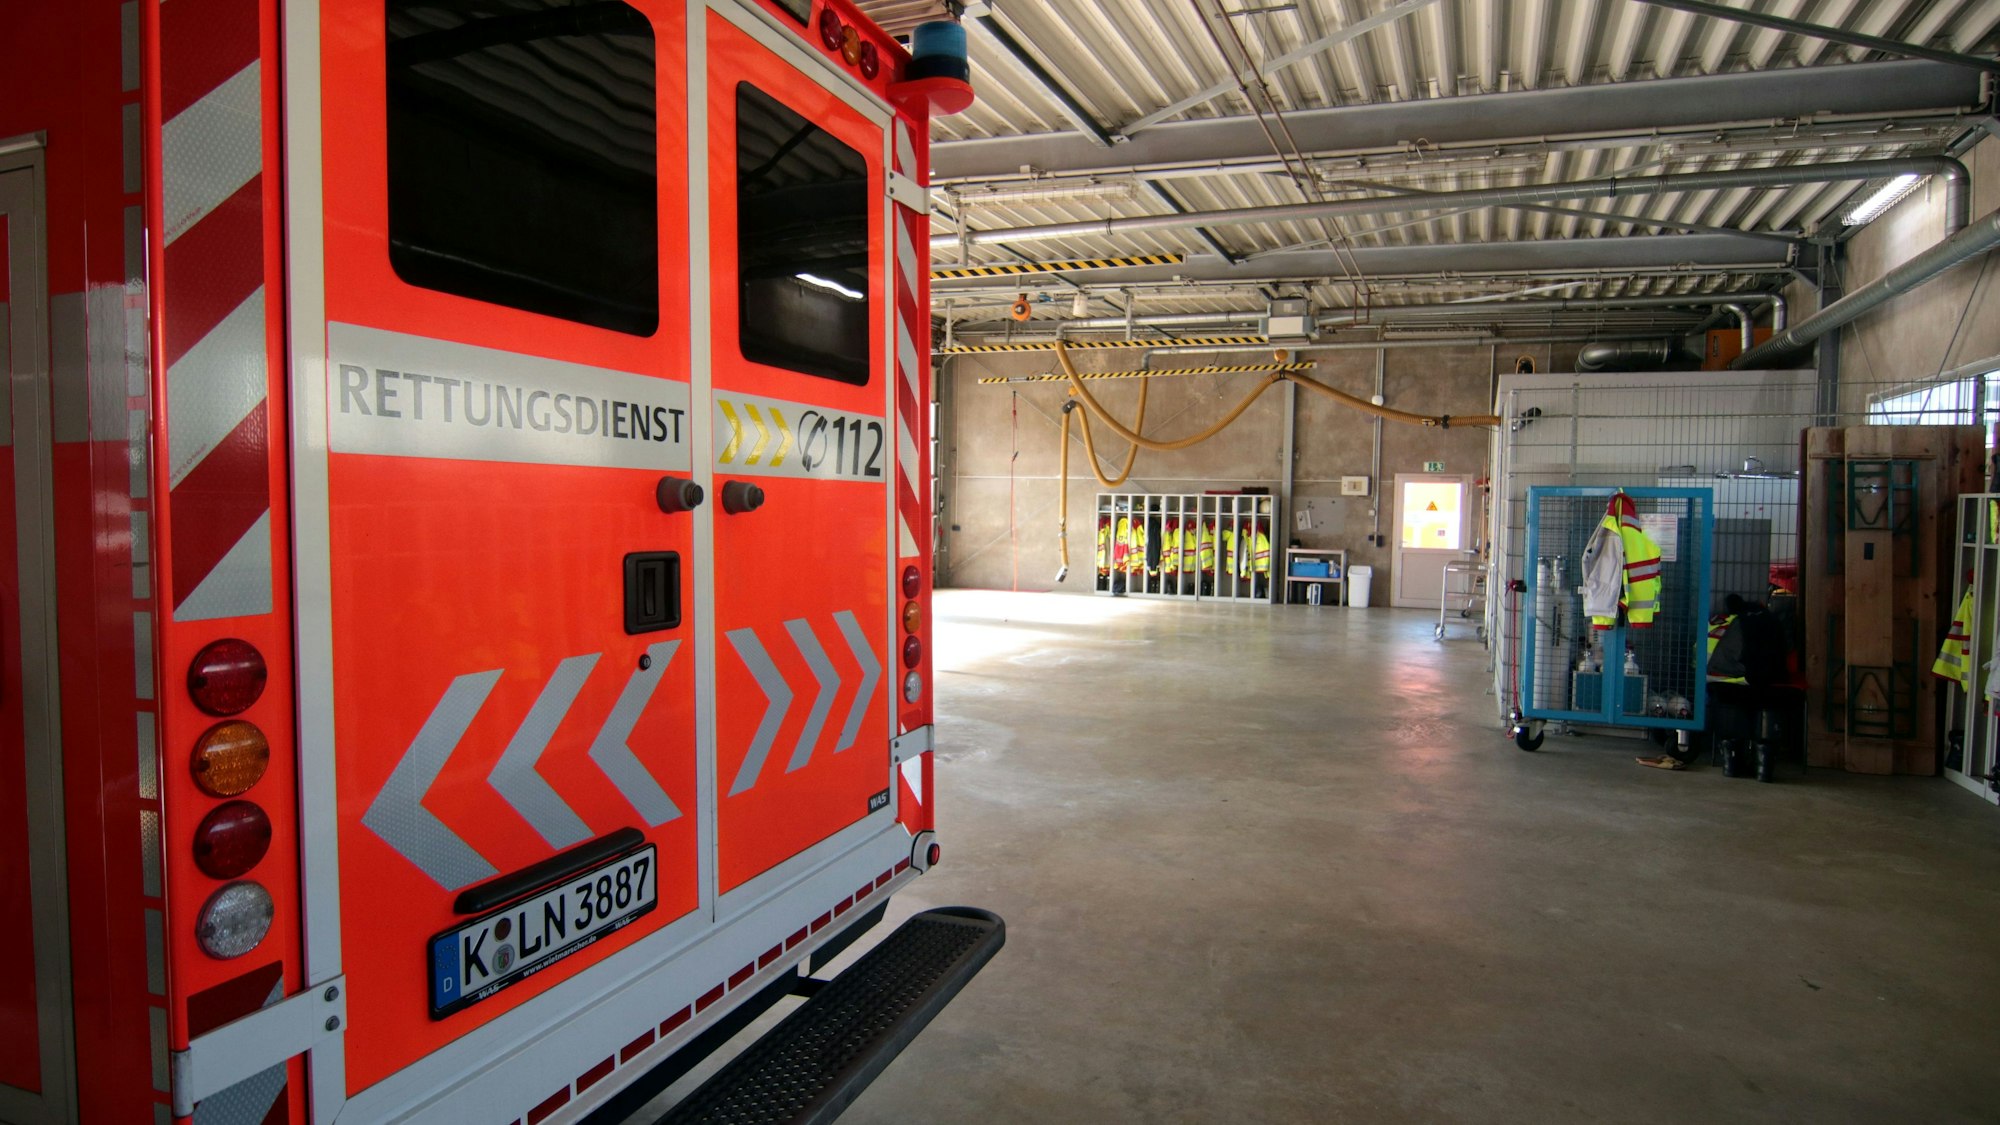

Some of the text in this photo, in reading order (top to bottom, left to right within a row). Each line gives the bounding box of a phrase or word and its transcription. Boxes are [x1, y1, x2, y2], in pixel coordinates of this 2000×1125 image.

[338, 363, 685, 444] RETTUNGSDIENST
[833, 416, 883, 477] 112
[870, 792, 888, 809] WAS
[464, 856, 650, 986] K LN 3887
[443, 976, 453, 993] D
[478, 983, 500, 999] WAS
